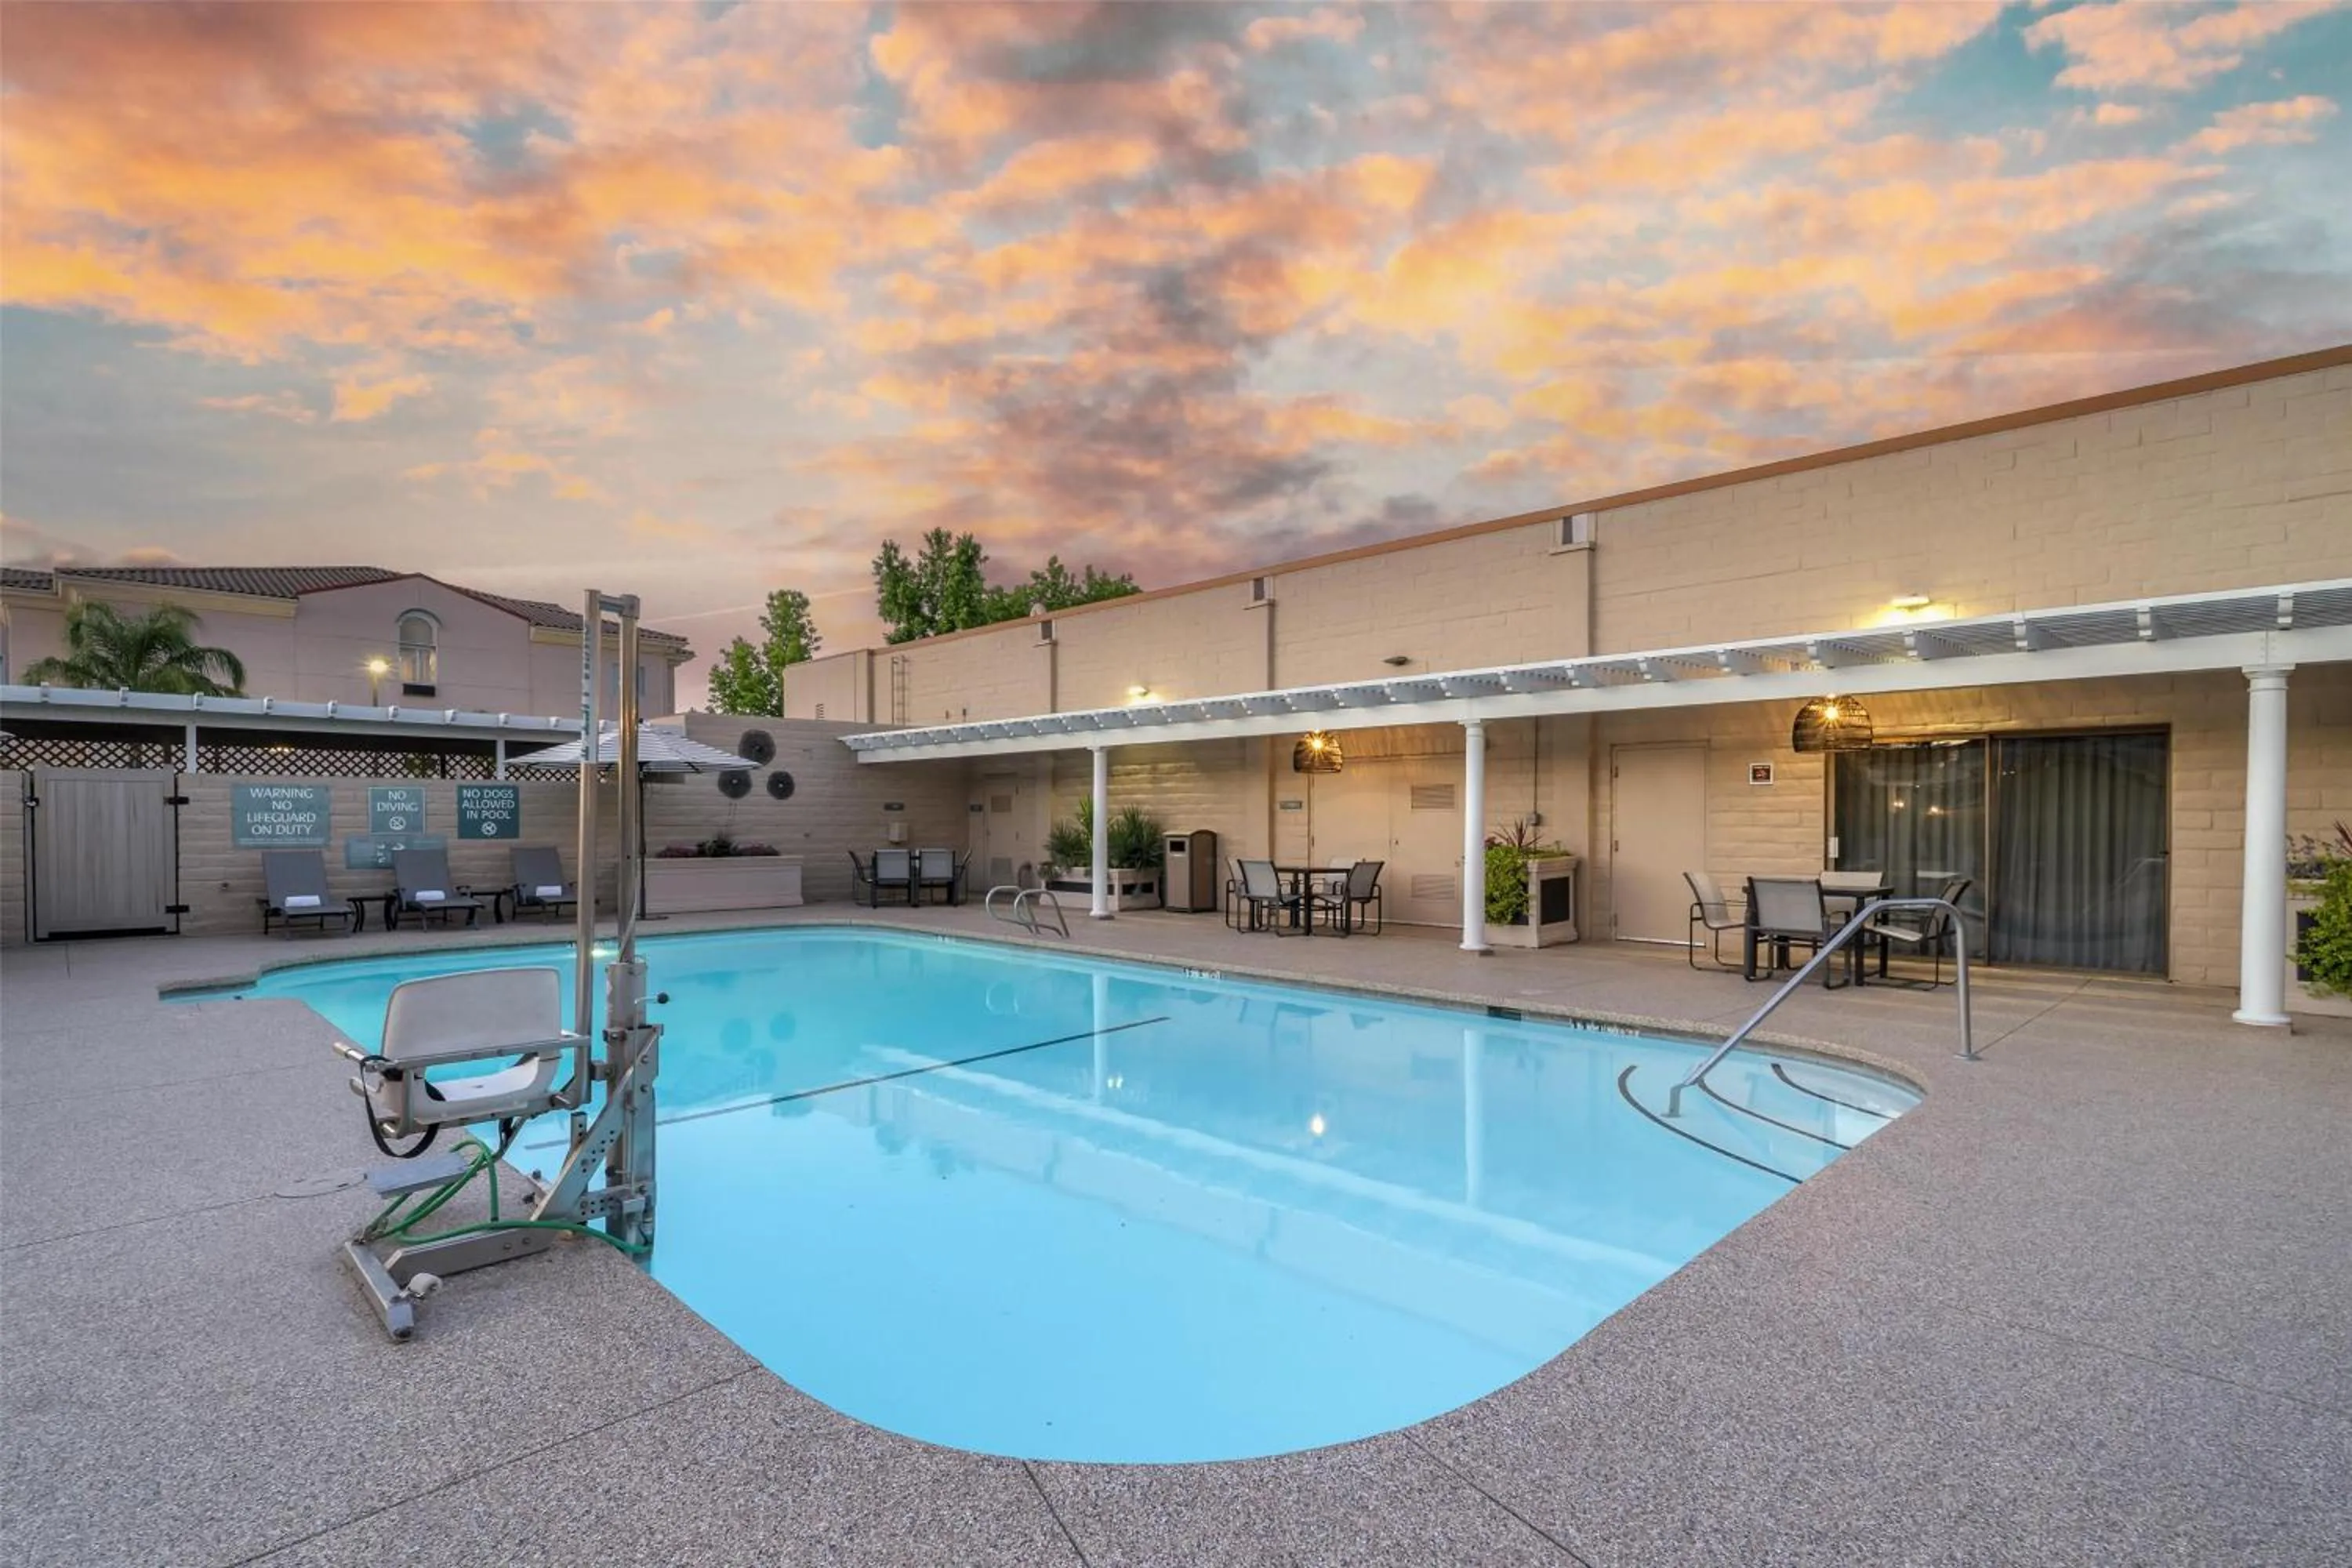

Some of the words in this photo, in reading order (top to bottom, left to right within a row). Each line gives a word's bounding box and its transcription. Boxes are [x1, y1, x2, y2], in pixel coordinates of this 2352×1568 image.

[250, 787, 314, 798] WARNING
[388, 789, 407, 800] NO
[463, 789, 481, 798] NO
[484, 789, 514, 798] DOGS
[271, 800, 292, 810] NO
[376, 802, 419, 811] DIVING
[462, 799, 514, 809] ALLOWED
[247, 812, 316, 822] LIFEGUARD
[466, 810, 478, 819] IN
[481, 810, 511, 819] POOL
[252, 824, 272, 835] ON
[276, 824, 313, 835] DUTY
